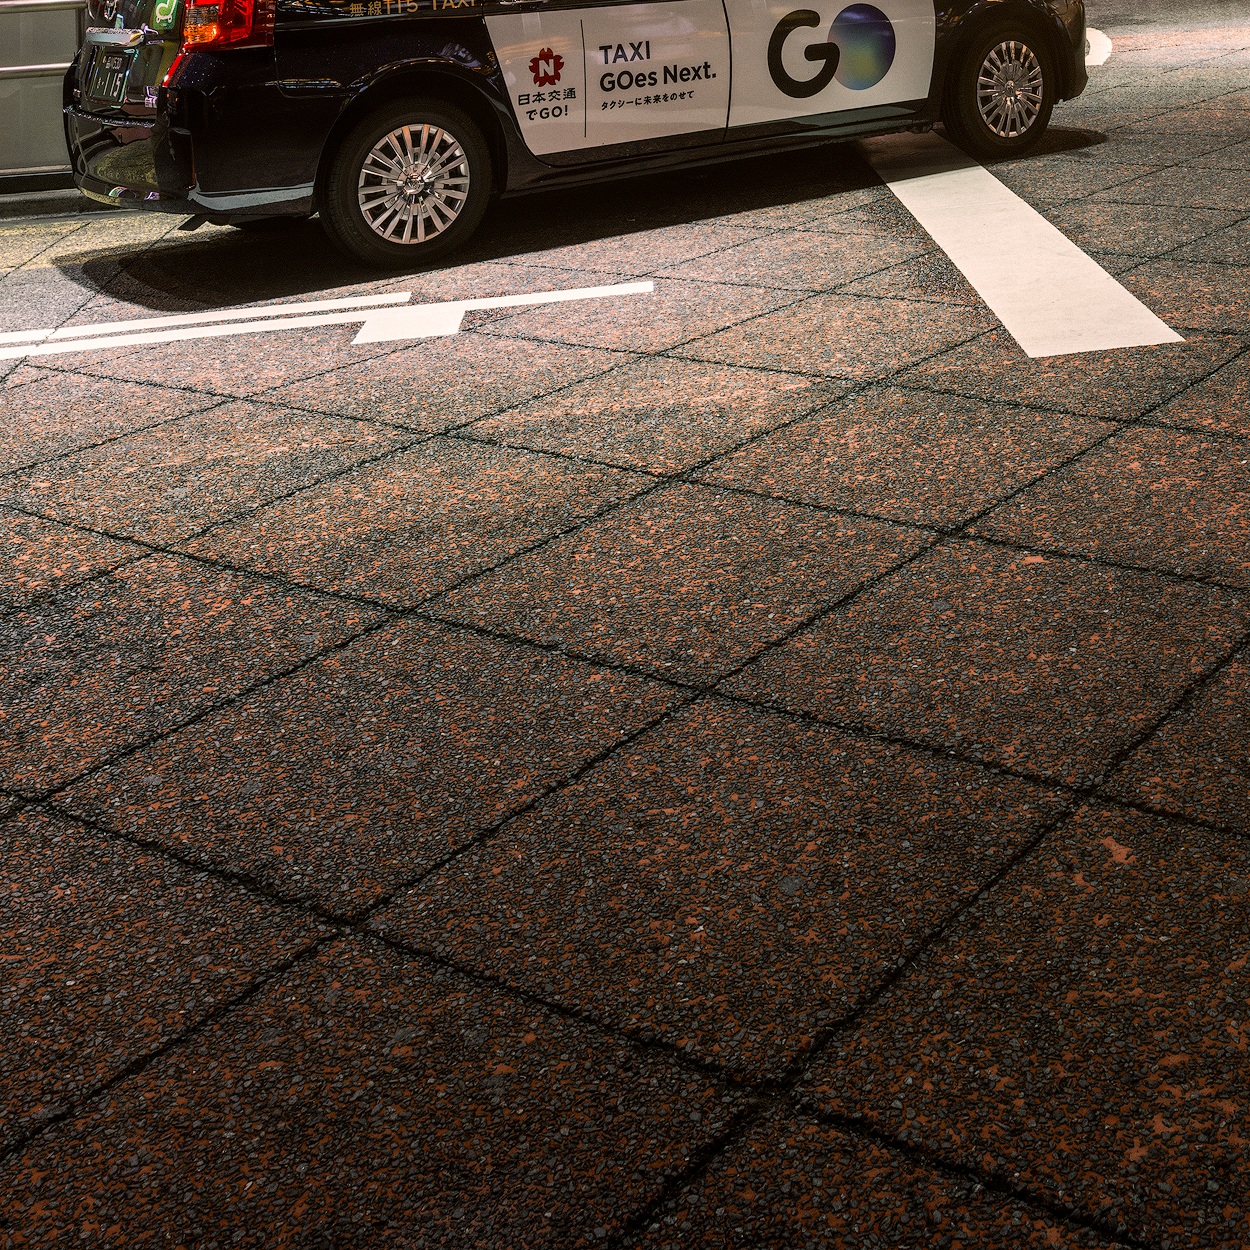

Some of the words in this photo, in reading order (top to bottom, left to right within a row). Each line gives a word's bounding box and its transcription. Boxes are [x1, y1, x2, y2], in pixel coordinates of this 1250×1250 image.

[599, 40, 650, 64] TAXI
[768, 3, 896, 99] GO
[600, 70, 657, 92] GOes
[663, 61, 716, 84] Next.
[518, 87, 576, 106] 日本交通
[601, 91, 694, 111] タクシーに未来をのせて
[526, 105, 568, 121] でGO!
